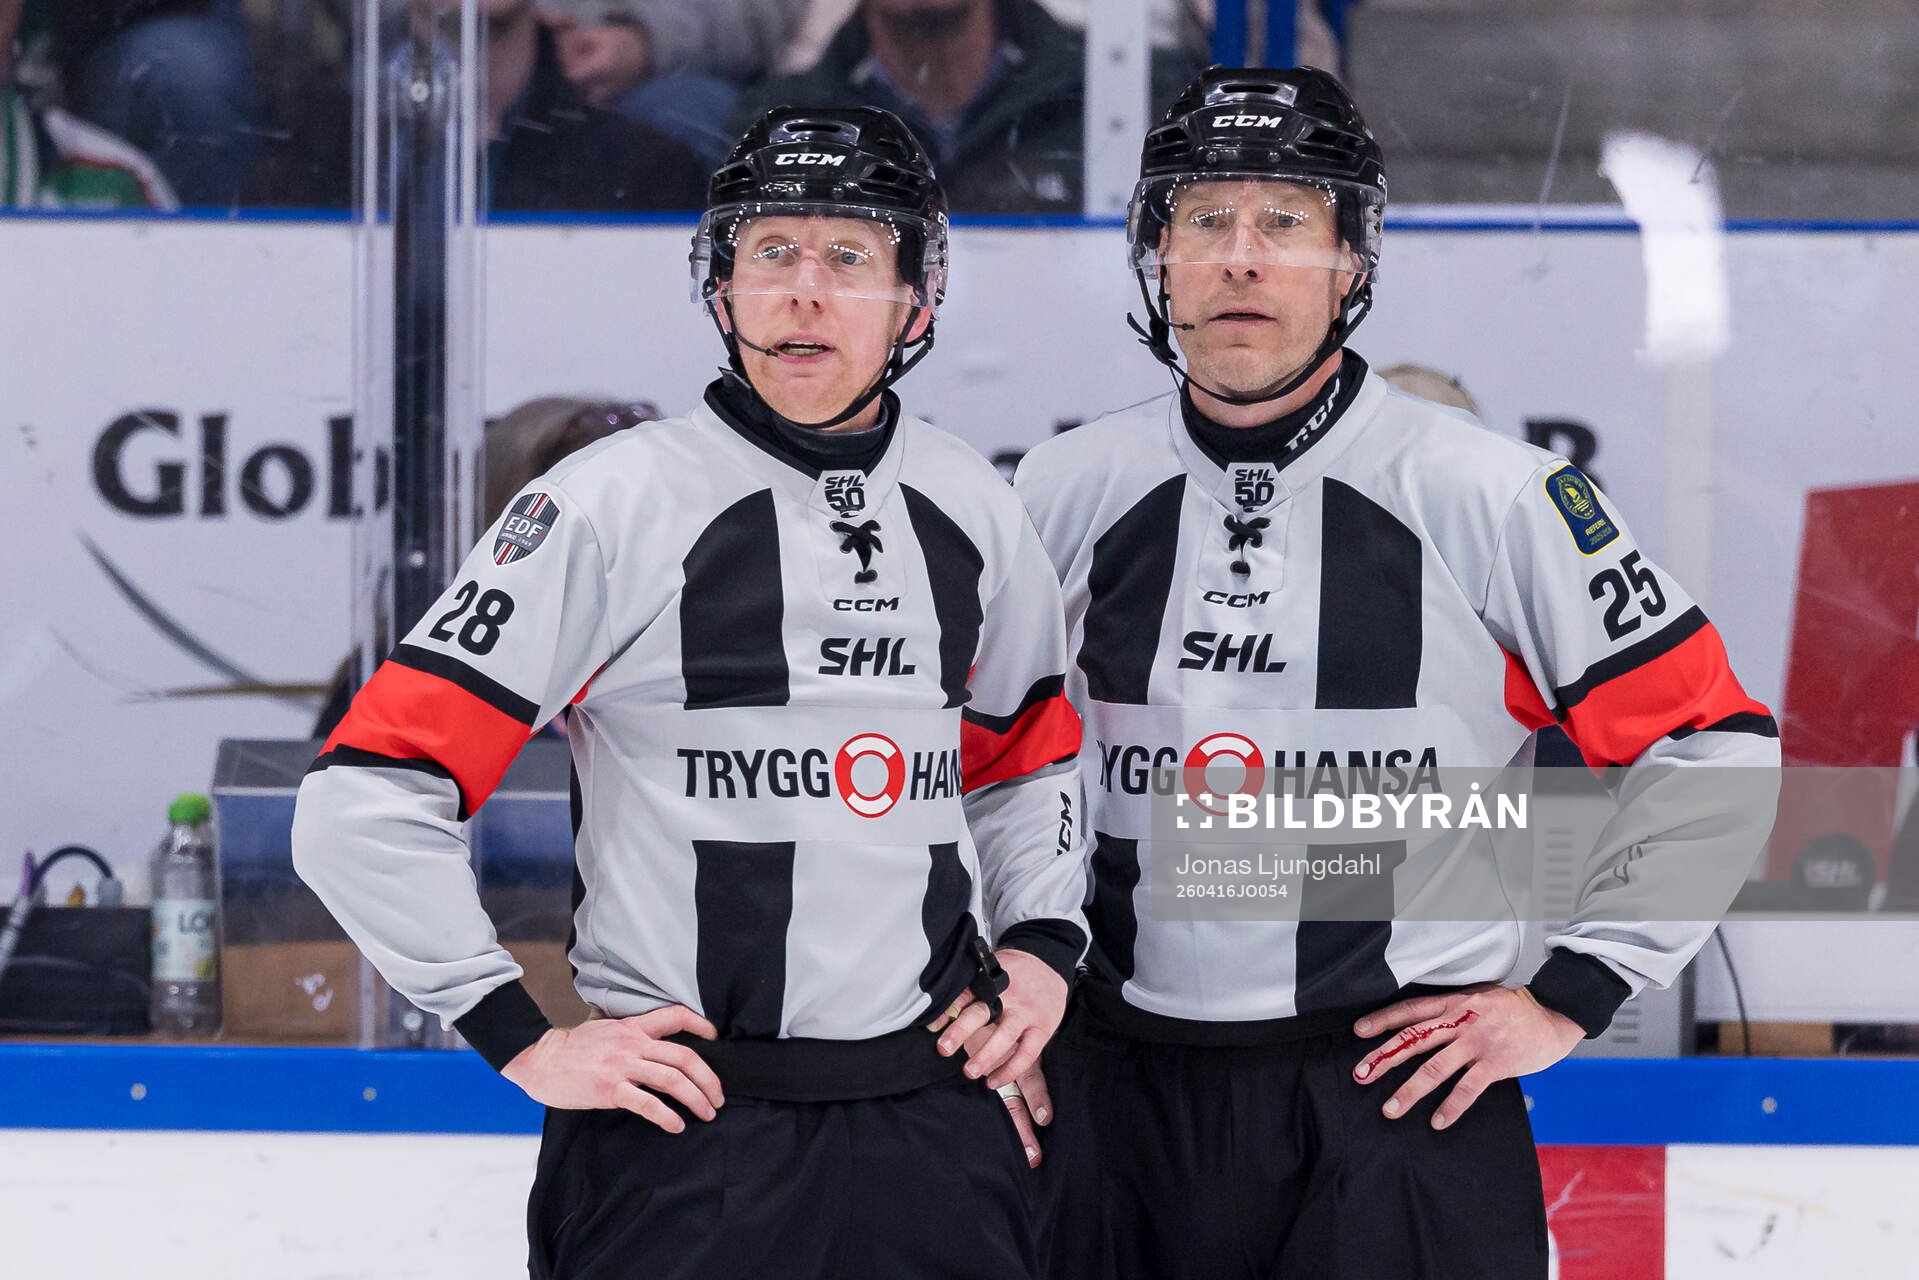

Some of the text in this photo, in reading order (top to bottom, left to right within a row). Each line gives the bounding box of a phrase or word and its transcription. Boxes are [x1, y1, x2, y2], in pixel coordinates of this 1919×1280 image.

[1212, 115, 1282, 129] CCM
[775, 153, 845, 168] CCM
[825, 475, 865, 489] SHL
[1235, 469, 1275, 481] SHL
[825, 487, 866, 512] 50
[1235, 481, 1275, 507] 50
[504, 516, 544, 538] EDF
[833, 597, 899, 612] CCM
[1202, 590, 1270, 609] CCM
[1589, 549, 1667, 641] 25
[429, 580, 515, 655] 28
[818, 637, 917, 677] SHL
[1177, 630, 1288, 673] SHL
[677, 748, 961, 801] TRYGG HAN
[1096, 740, 1178, 796] YGG
[1056, 791, 1073, 857] CM
